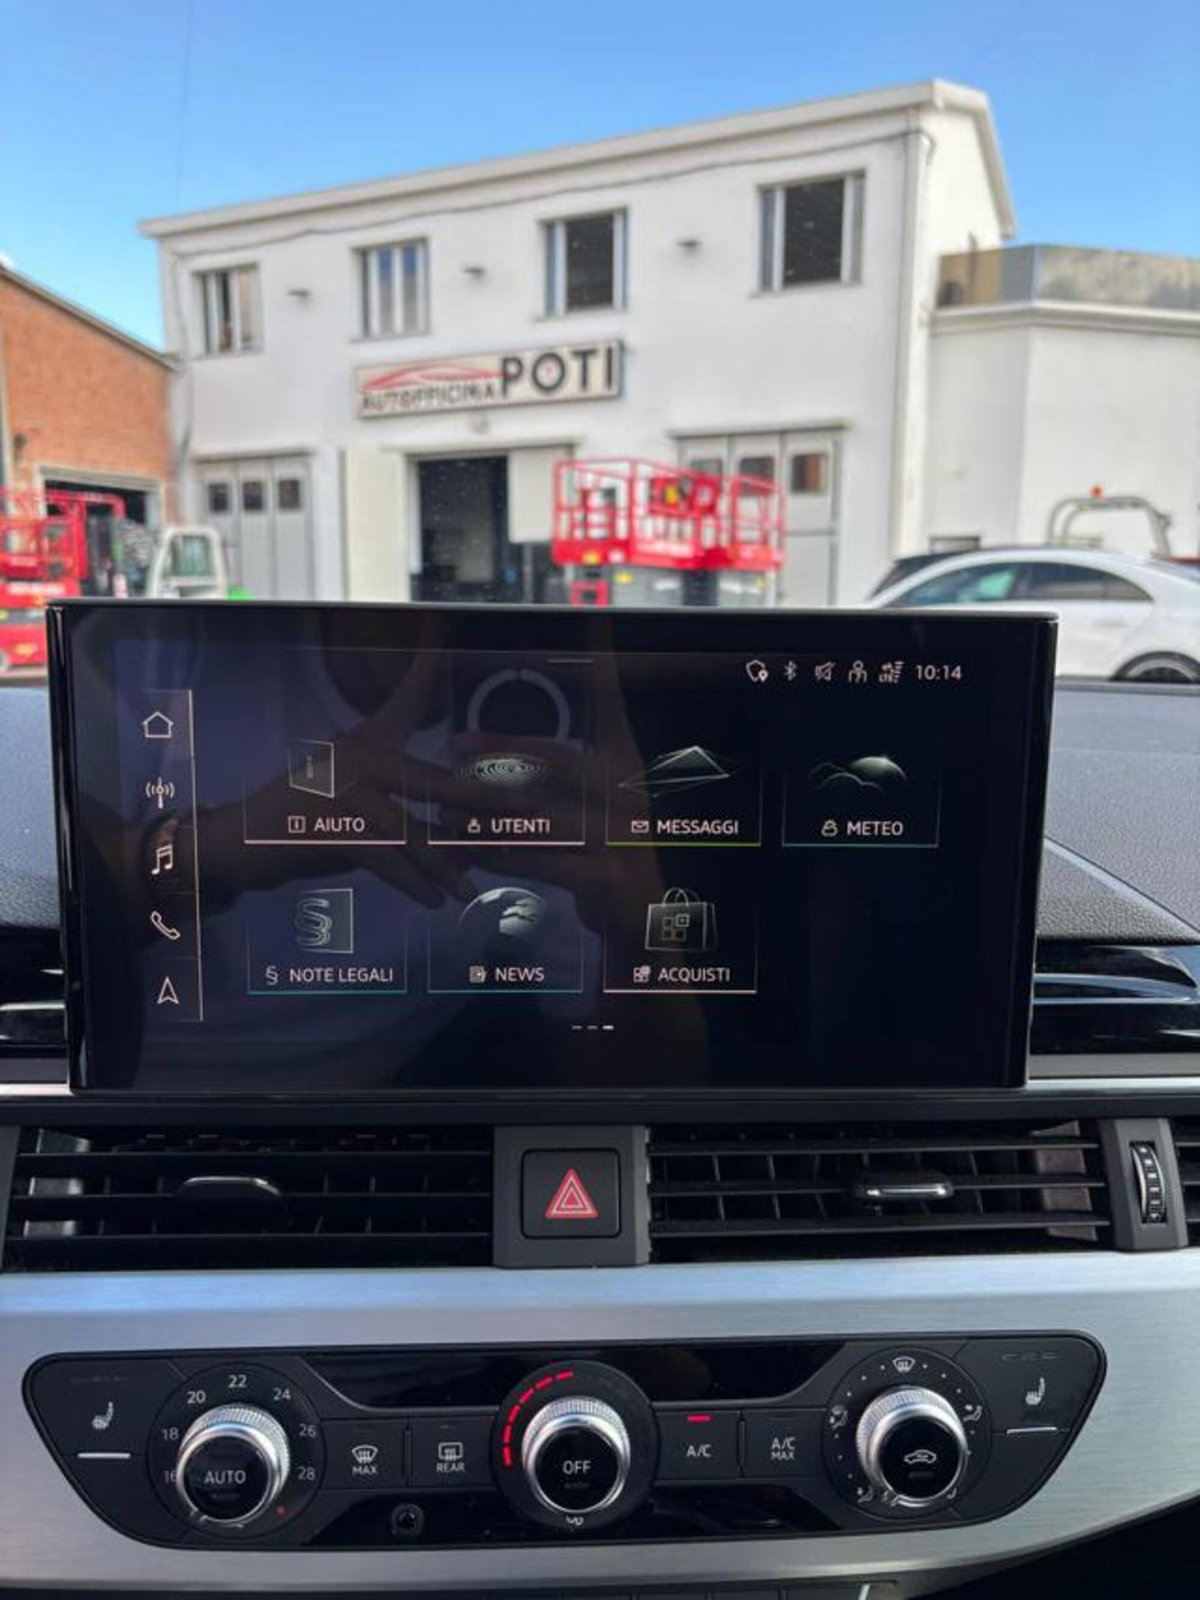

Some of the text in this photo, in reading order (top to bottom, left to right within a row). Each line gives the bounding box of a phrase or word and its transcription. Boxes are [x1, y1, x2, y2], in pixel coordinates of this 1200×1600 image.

[500, 346, 613, 398] POTI
[915, 664, 962, 681] 10:14
[313, 817, 366, 833] AIUTO
[490, 818, 551, 834] UTENTI
[656, 819, 739, 835] MESSAGGI
[847, 820, 904, 836] METEO
[289, 967, 394, 983] NOTE LEGALI
[494, 967, 545, 983] NEWS
[657, 967, 731, 984] ACQUISTI
[228, 1375, 247, 1388] 22
[187, 1391, 206, 1404] 20
[273, 1388, 291, 1401] 24
[162, 1428, 179, 1441] 18
[299, 1424, 317, 1438] 26
[771, 1436, 796, 1450] A/C
[686, 1444, 712, 1459] A/C
[771, 1451, 796, 1461] MAX
[298, 1467, 316, 1481] 28
[352, 1465, 379, 1475] MAX
[436, 1462, 465, 1474] REAR
[562, 1461, 591, 1475] OFF
[163, 1470, 178, 1483] 16
[204, 1470, 246, 1485] AUTO
